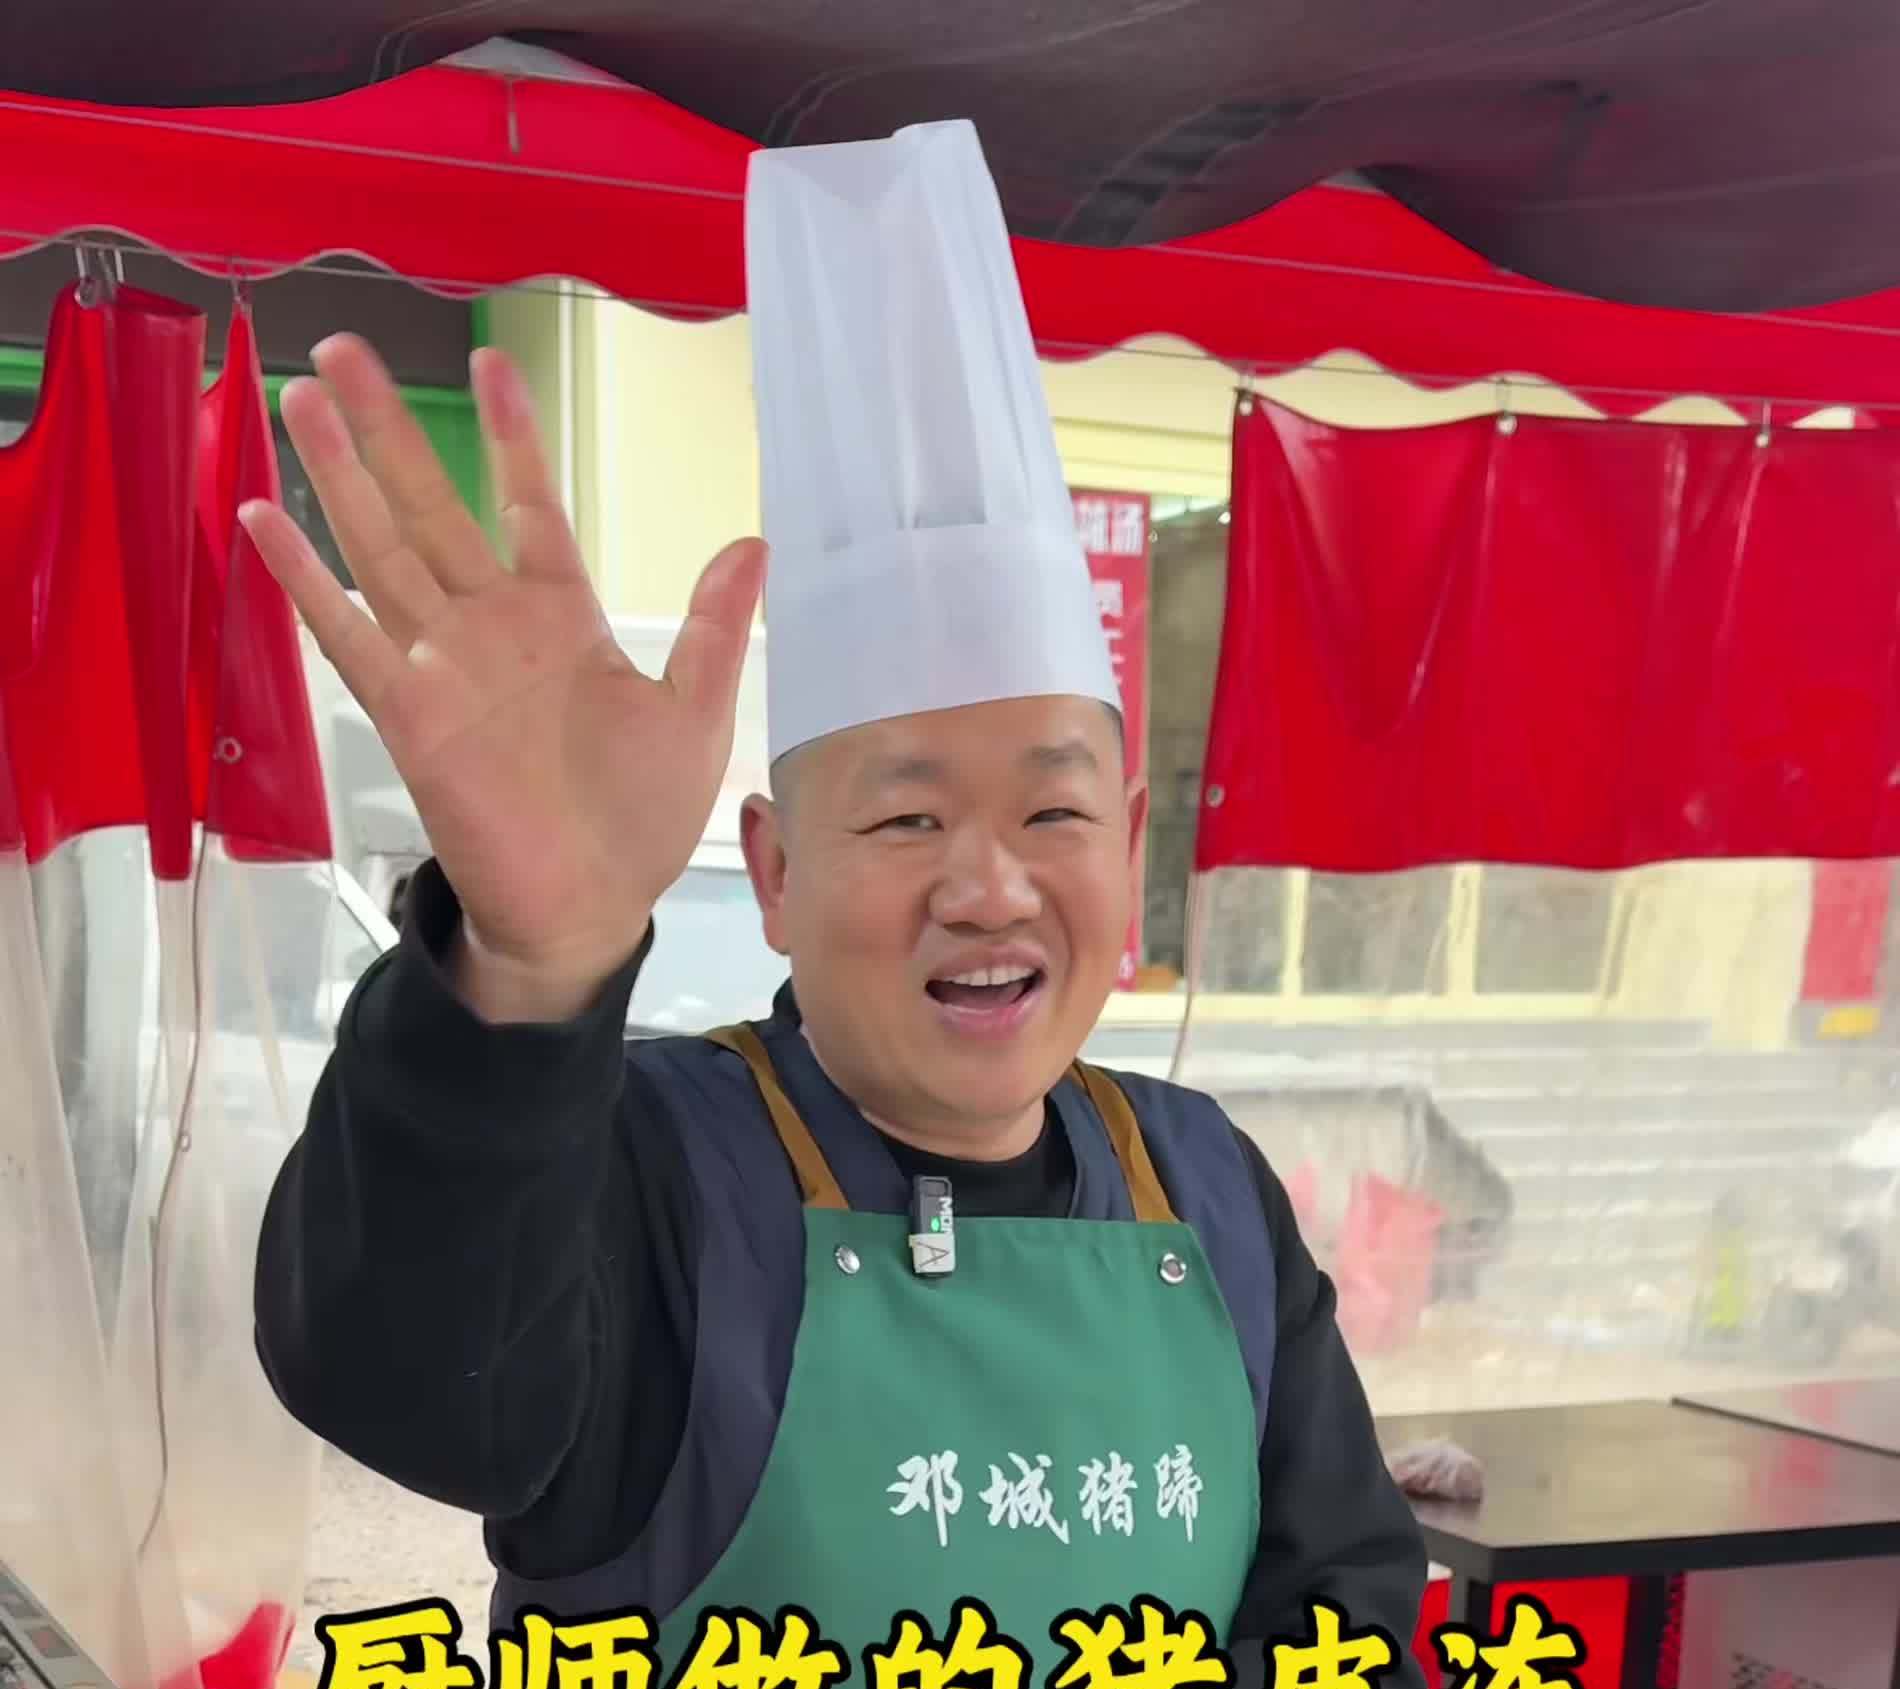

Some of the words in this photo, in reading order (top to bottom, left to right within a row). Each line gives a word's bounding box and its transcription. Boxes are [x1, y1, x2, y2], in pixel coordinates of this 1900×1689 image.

[916, 1241, 950, 1268] A
[887, 1444, 1204, 1547] 邓城猪蹄
